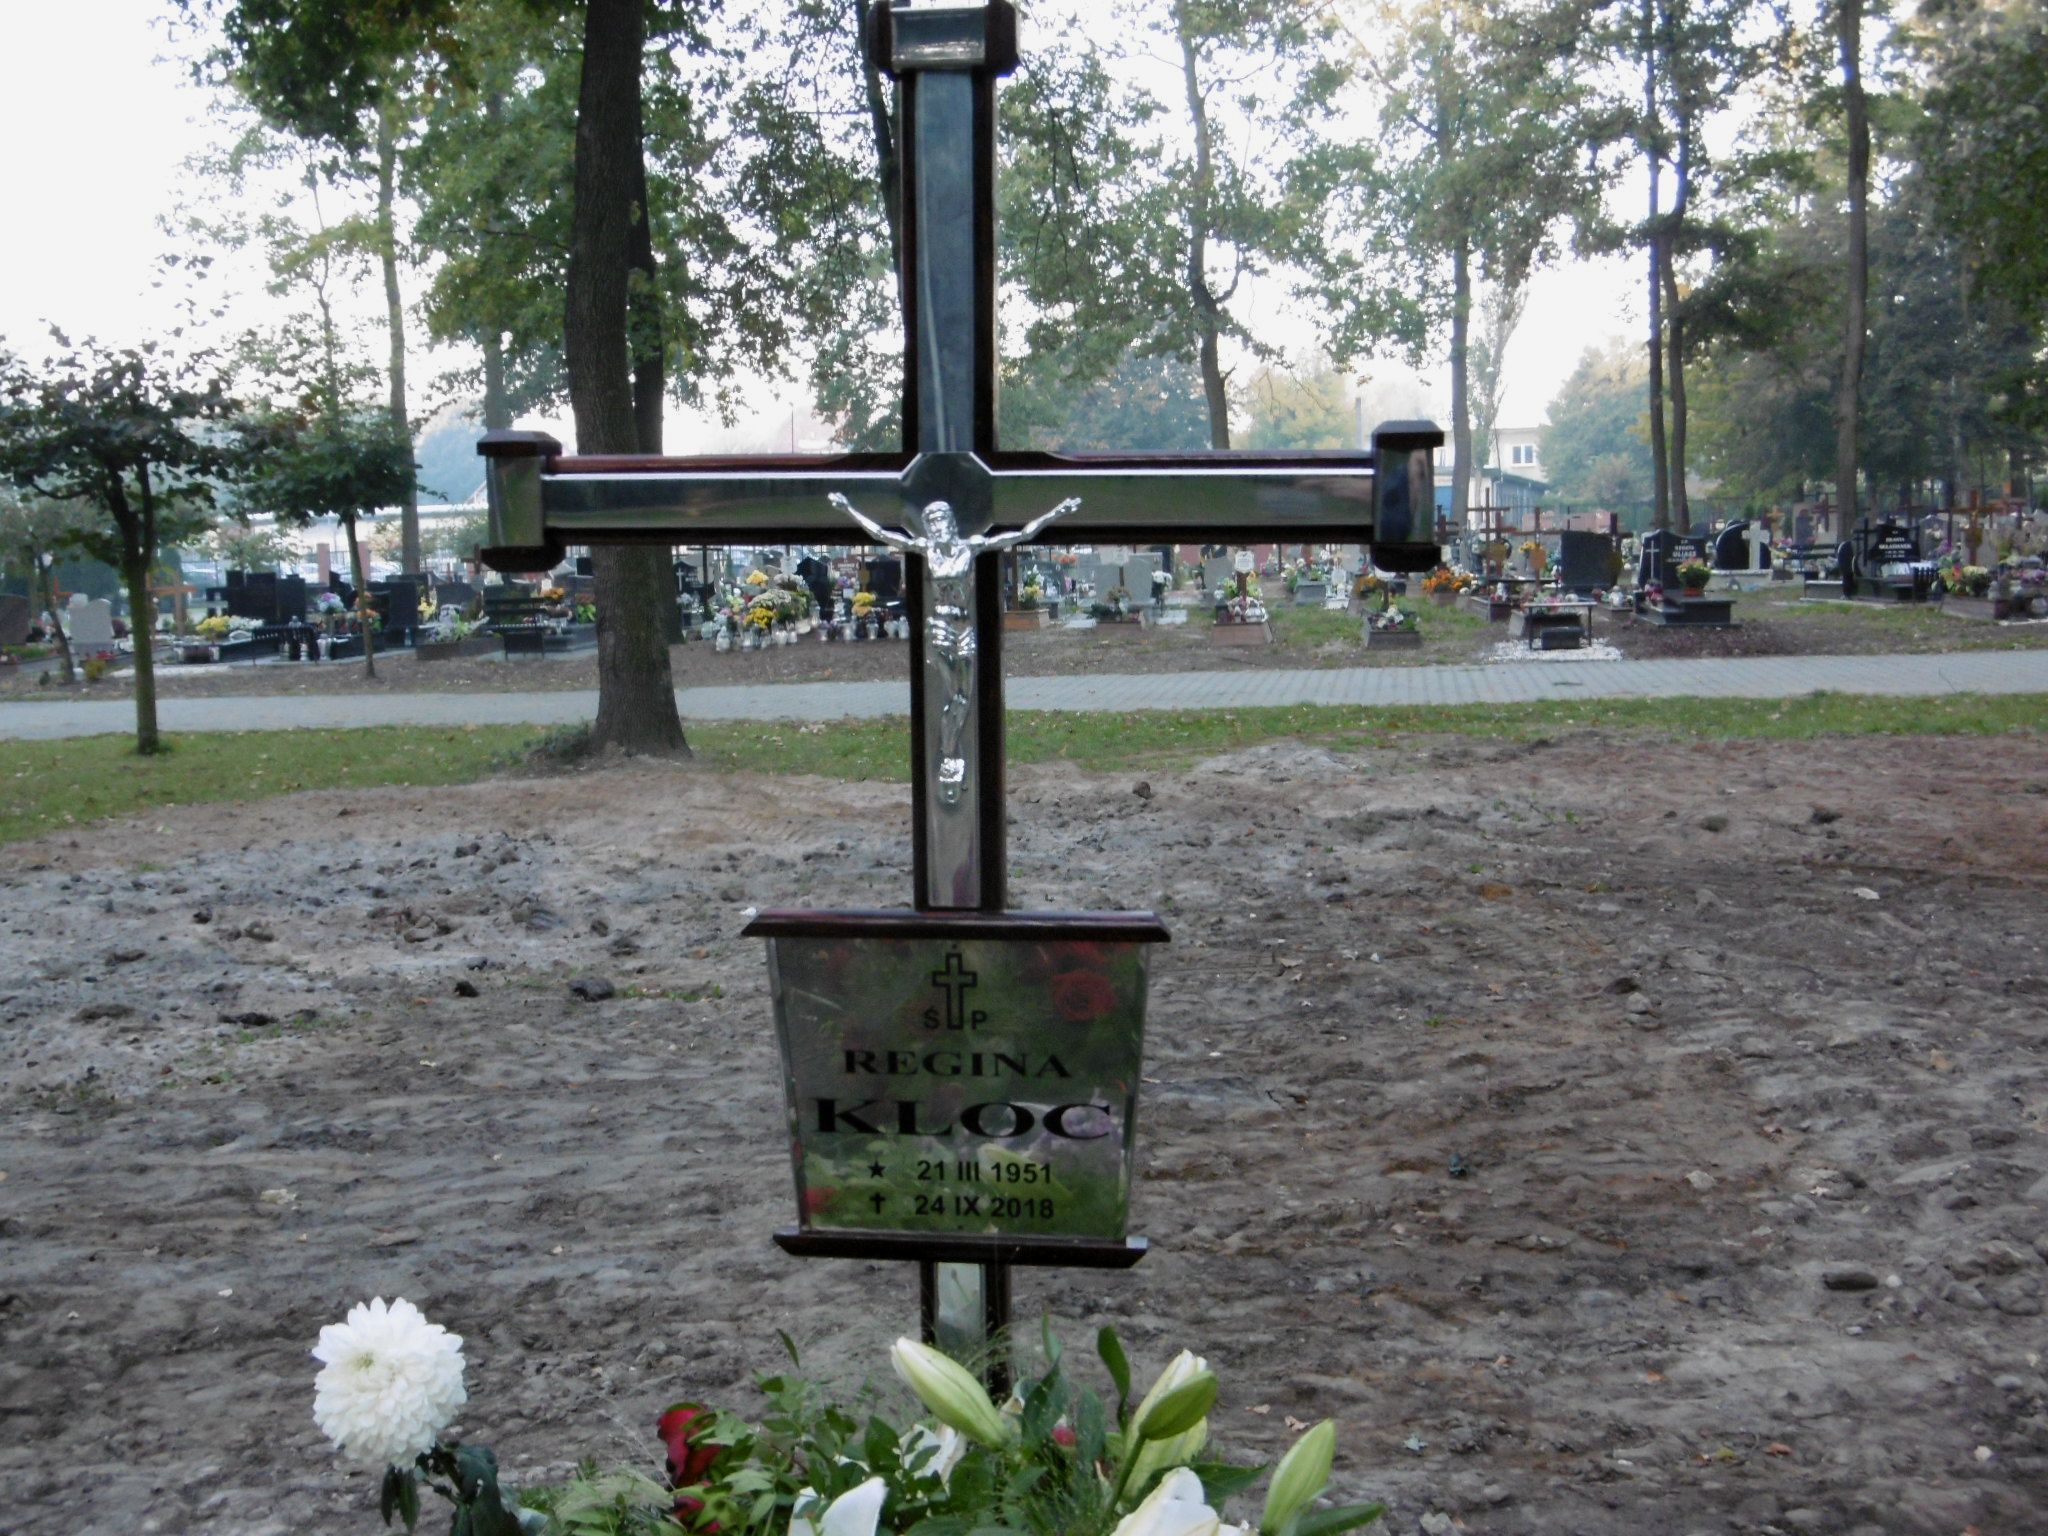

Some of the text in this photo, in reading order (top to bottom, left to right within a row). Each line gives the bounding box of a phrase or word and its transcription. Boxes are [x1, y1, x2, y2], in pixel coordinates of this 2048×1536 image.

[971, 1009, 988, 1031] P
[843, 1048, 1072, 1079] REGINA
[813, 1097, 1111, 1140] KLOC
[916, 1160, 1052, 1184] 21 III 1951
[914, 1194, 1055, 1219] 24 IX 2018
